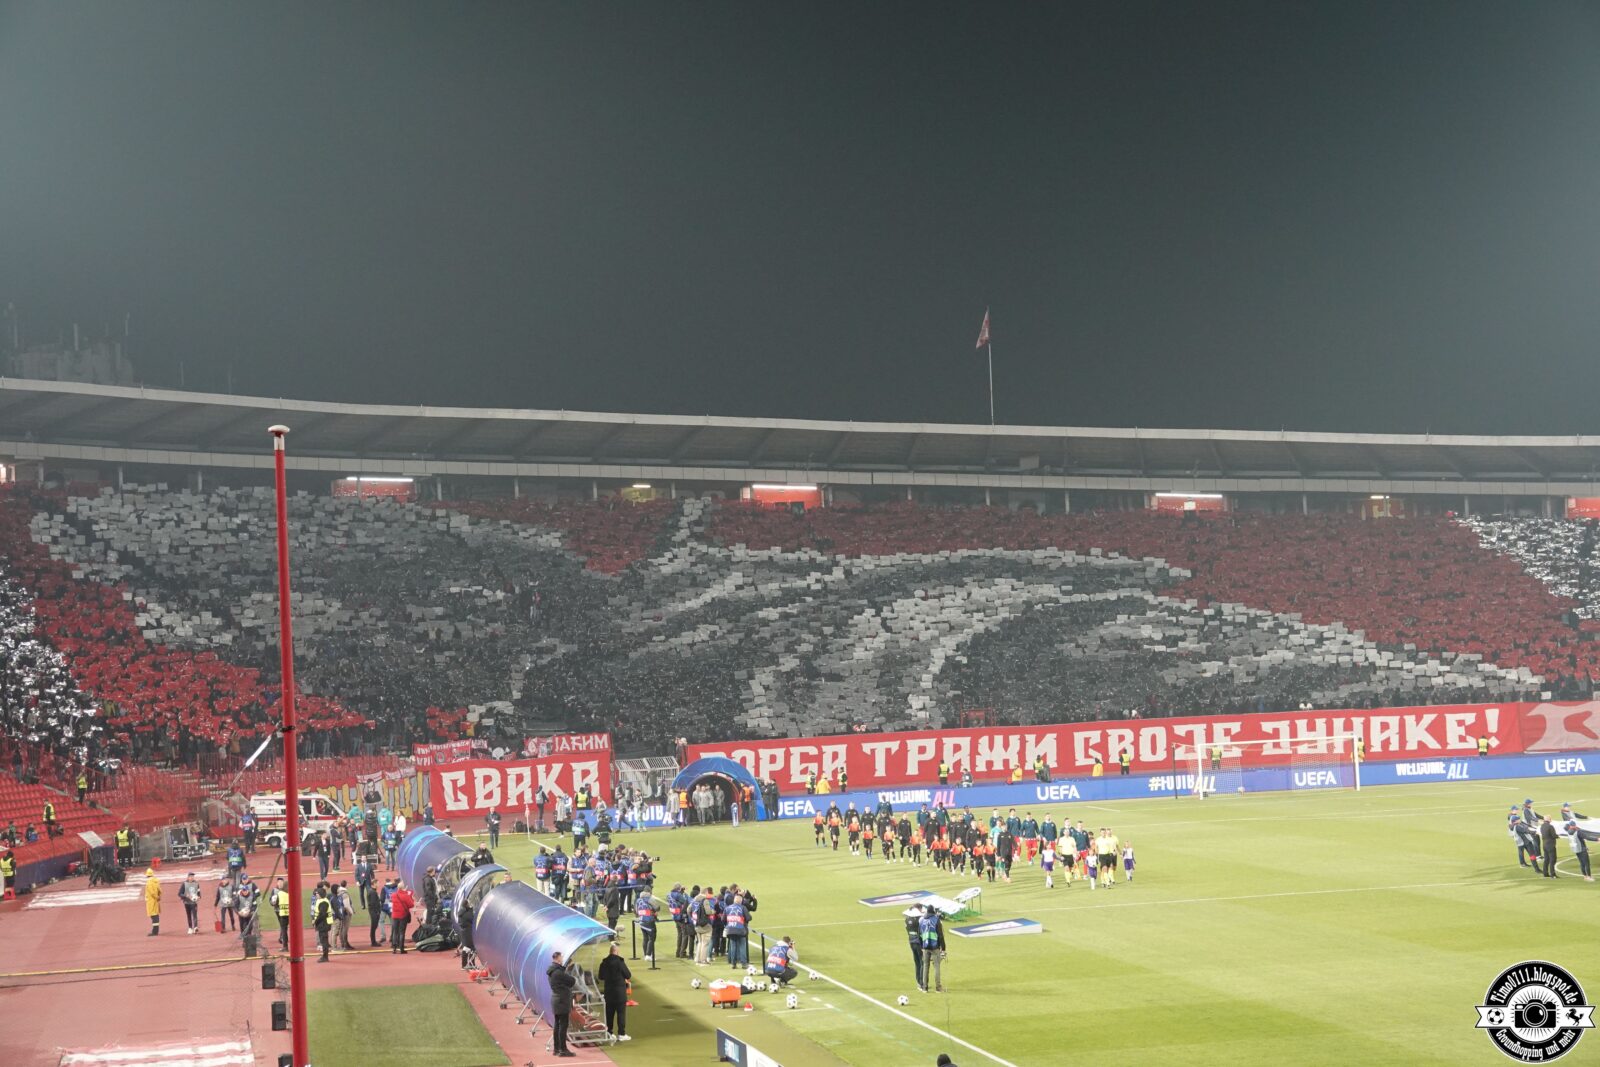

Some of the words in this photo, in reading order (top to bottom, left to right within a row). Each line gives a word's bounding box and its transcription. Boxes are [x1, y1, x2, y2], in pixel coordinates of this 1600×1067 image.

[861, 733, 1058, 777] ТРАЖИ
[1073, 722, 1243, 766] СВОЈЕ
[1447, 763, 1469, 779] ALL
[1544, 758, 1586, 774] UEFA
[440, 760, 600, 811] СВАКА
[1294, 770, 1337, 787] UEFA
[932, 790, 956, 808] ALL
[1036, 784, 1081, 801] UEFA
